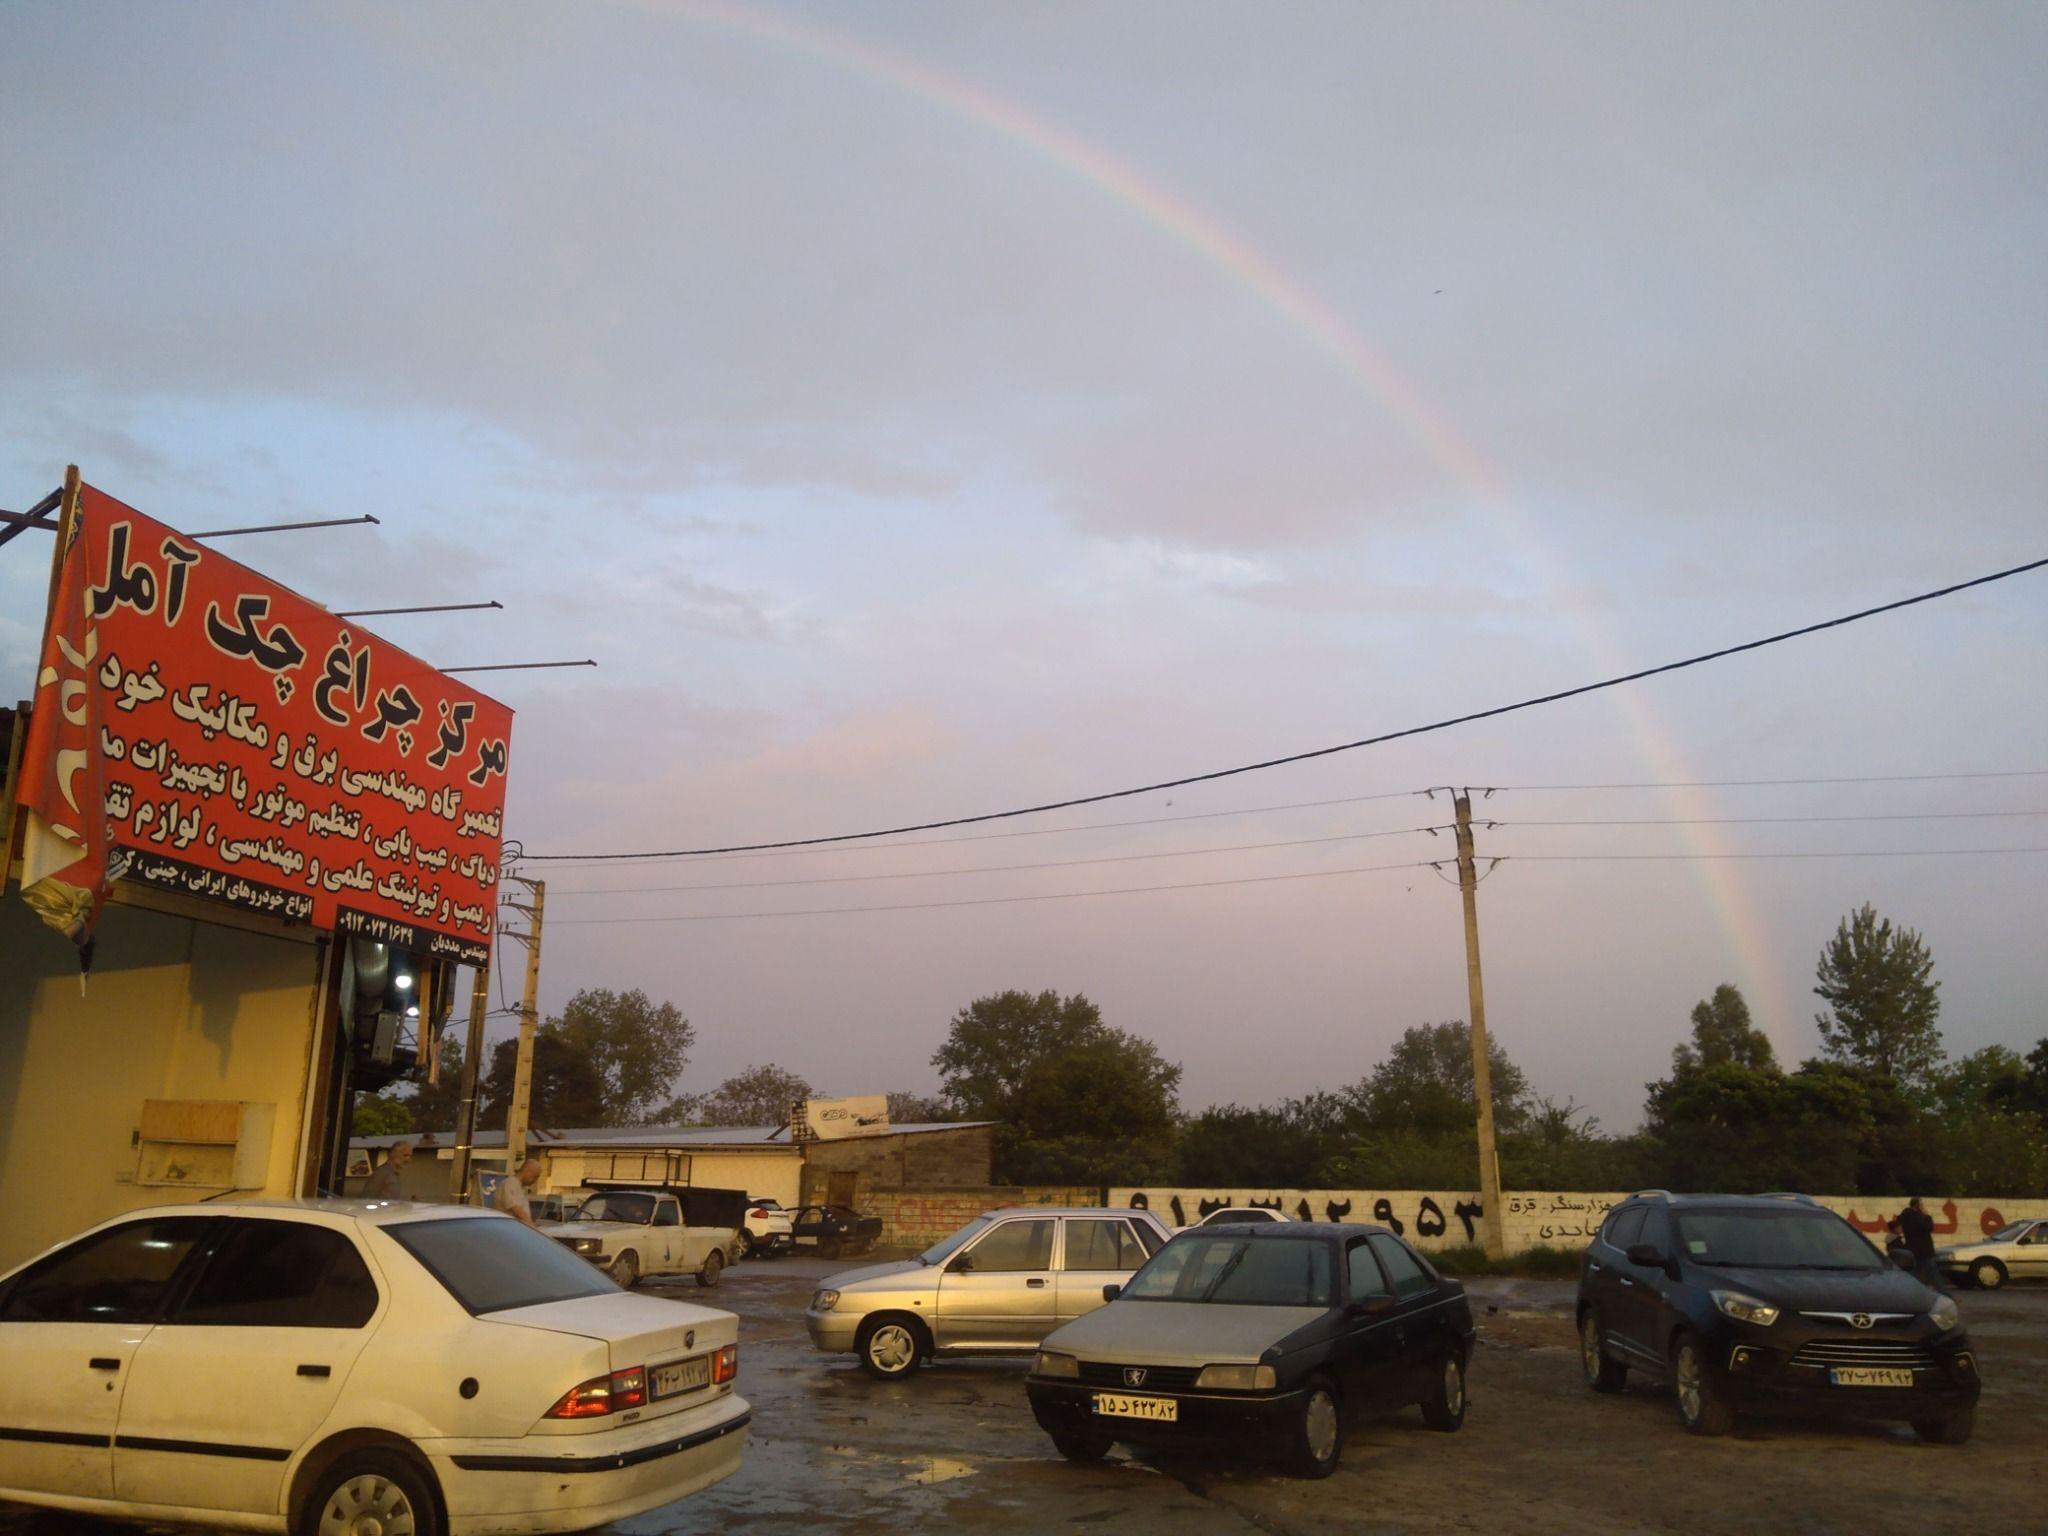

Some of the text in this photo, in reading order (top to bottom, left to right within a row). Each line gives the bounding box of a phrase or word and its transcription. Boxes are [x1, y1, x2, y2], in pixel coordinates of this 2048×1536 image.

[86, 521, 201, 628] آمل
[205, 594, 307, 705] چک
[313, 629, 423, 758] چراغ
[171, 684, 270, 749] مکانیک
[271, 731, 290, 769] و
[293, 732, 338, 786] برق
[427, 699, 507, 788] مرکز
[131, 738, 229, 799] تجهیزات
[230, 767, 248, 811] با
[340, 767, 427, 814] مهندسی
[134, 799, 202, 849] لوازم
[249, 783, 306, 828] موتور
[307, 802, 361, 840] تنظیم
[305, 857, 321, 886] و
[322, 857, 374, 892] علمی
[415, 845, 448, 873] عیب
[226, 879, 285, 911] خودروهای
[284, 897, 314, 918] انواع
[376, 872, 441, 917] تیونینگ
[438, 898, 451, 923] و
[453, 901, 491, 934] ریمپ
